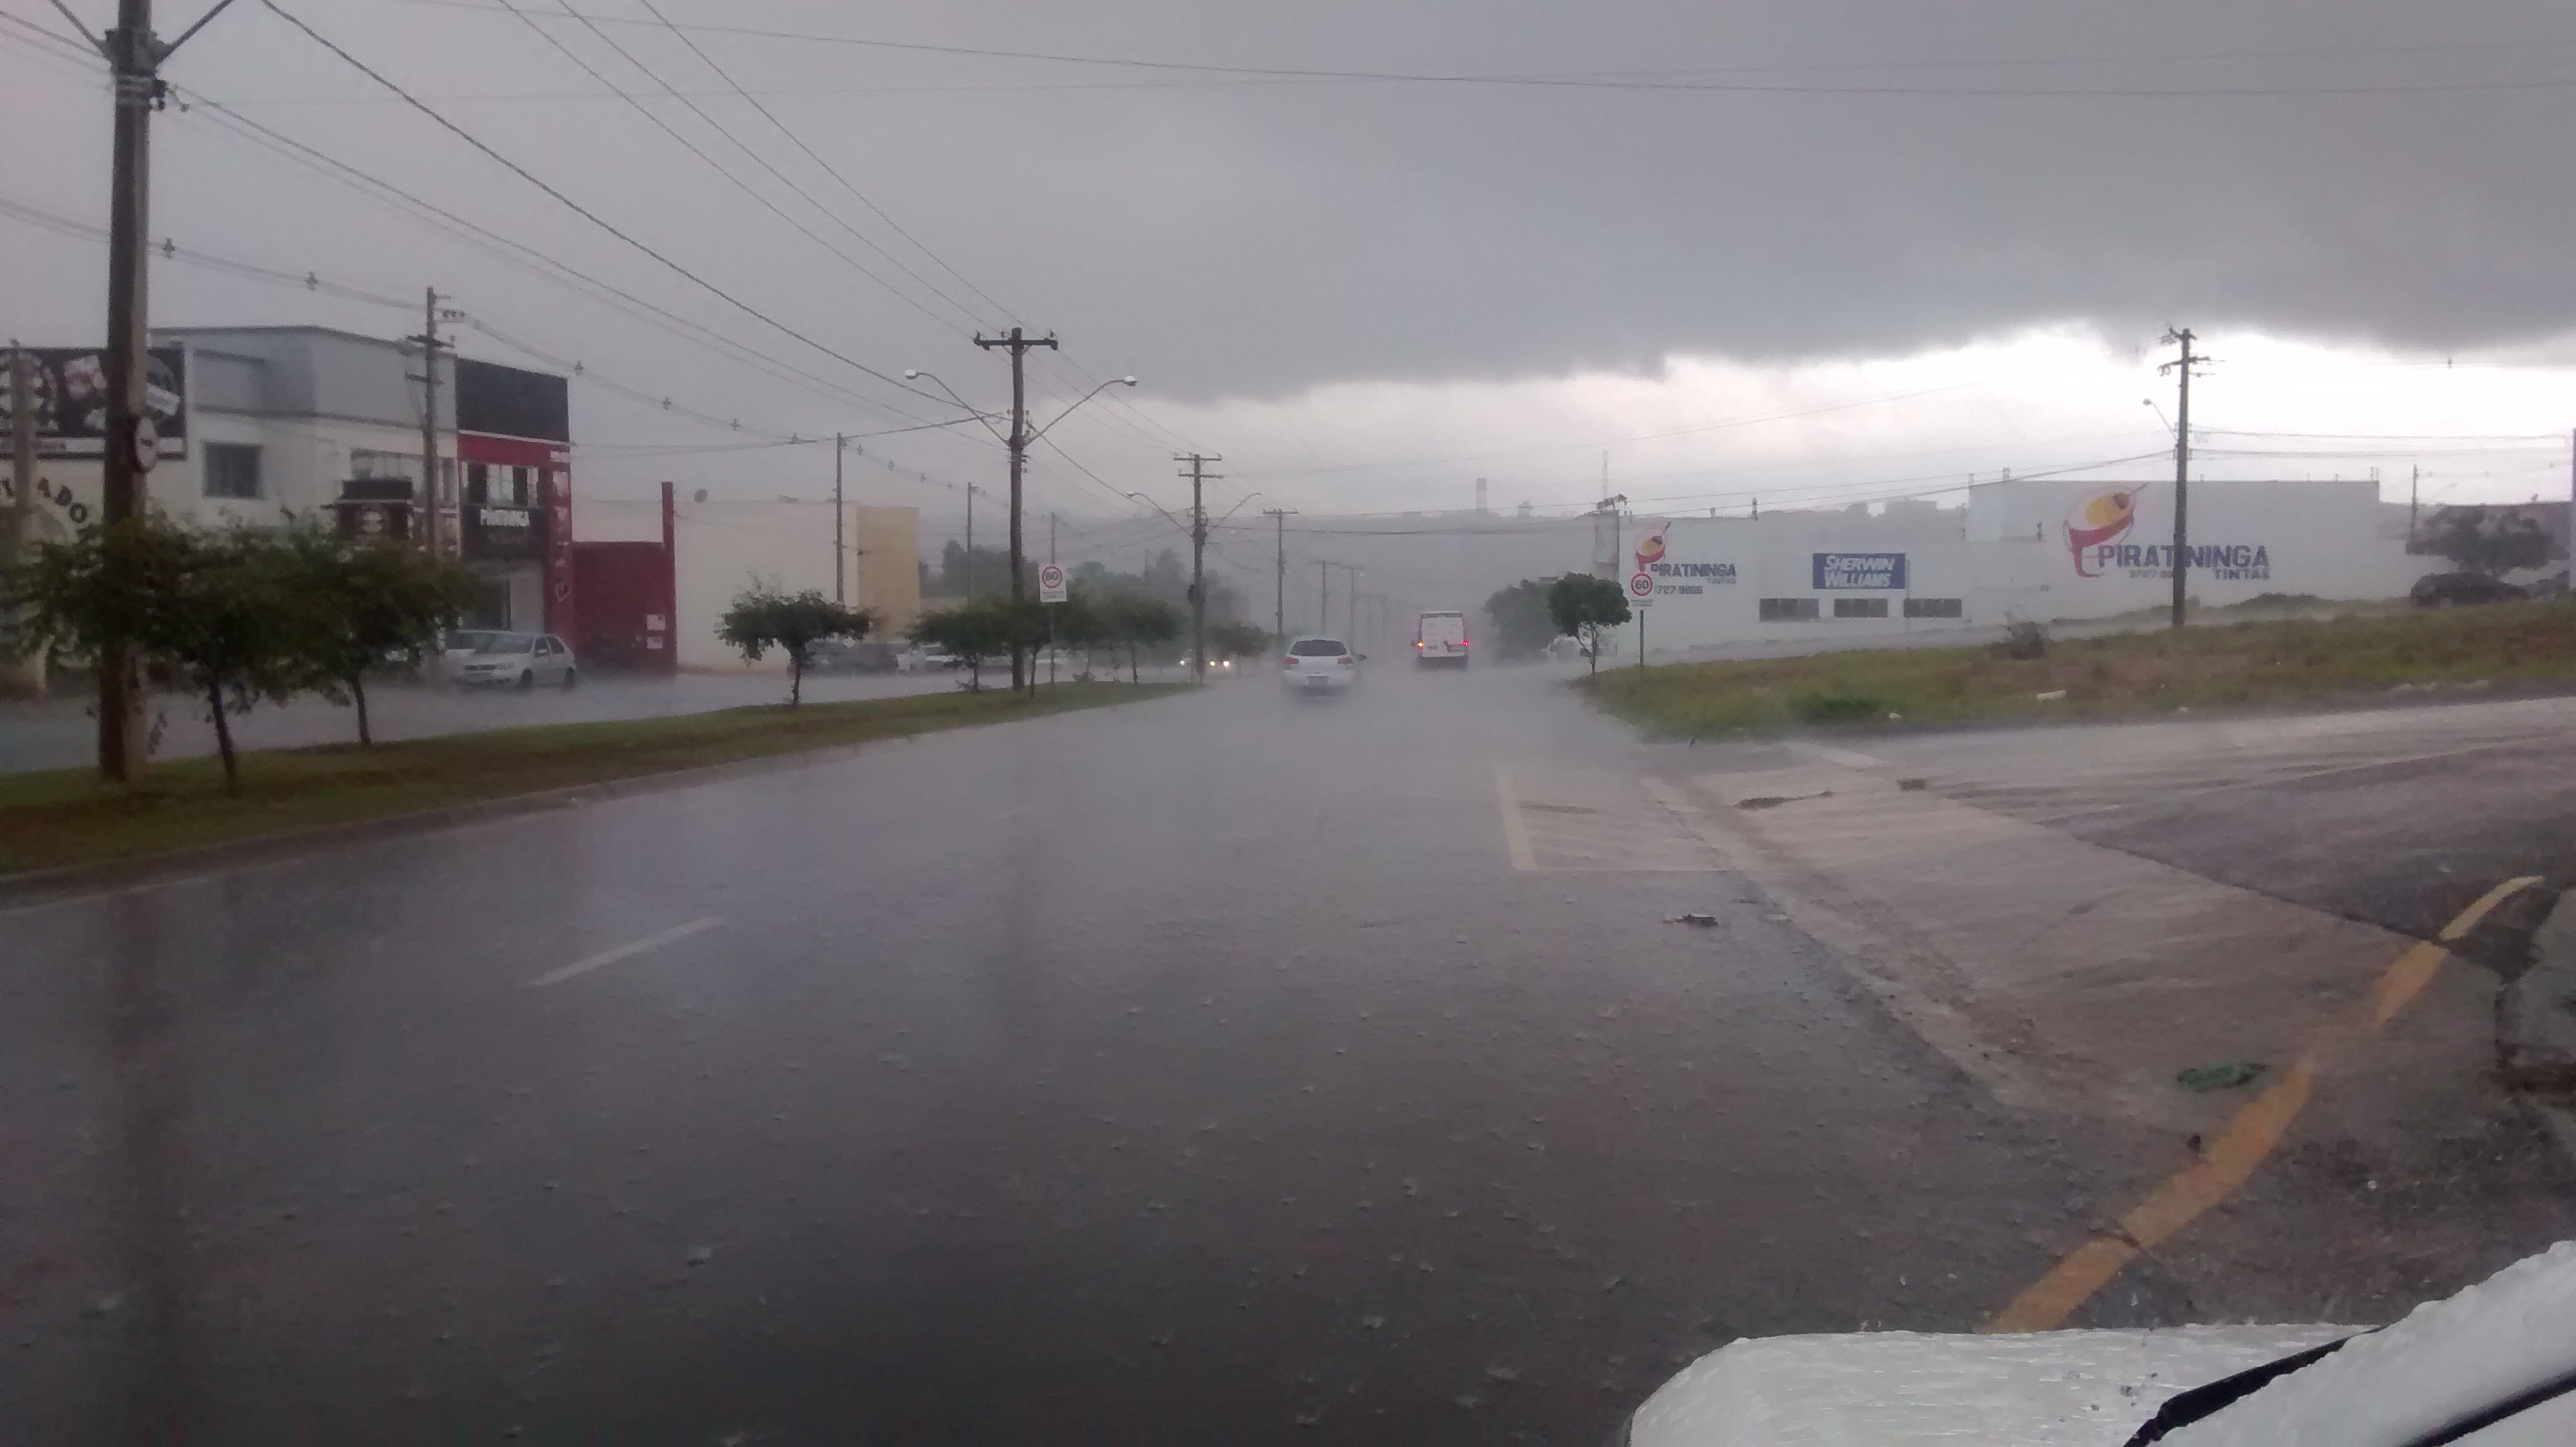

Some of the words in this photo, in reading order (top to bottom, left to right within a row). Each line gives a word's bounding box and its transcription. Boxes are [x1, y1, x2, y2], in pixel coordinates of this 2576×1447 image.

[1825, 555, 1895, 571] SHERWIN
[2098, 544, 2270, 568] PIRATNINGA
[1045, 571, 1059, 581] 60
[1650, 563, 1737, 577] PIRATININGA
[2213, 569, 2270, 580] TINTAS
[1635, 579, 1650, 590] 60
[1824, 567, 1892, 588] WILLIAMS
